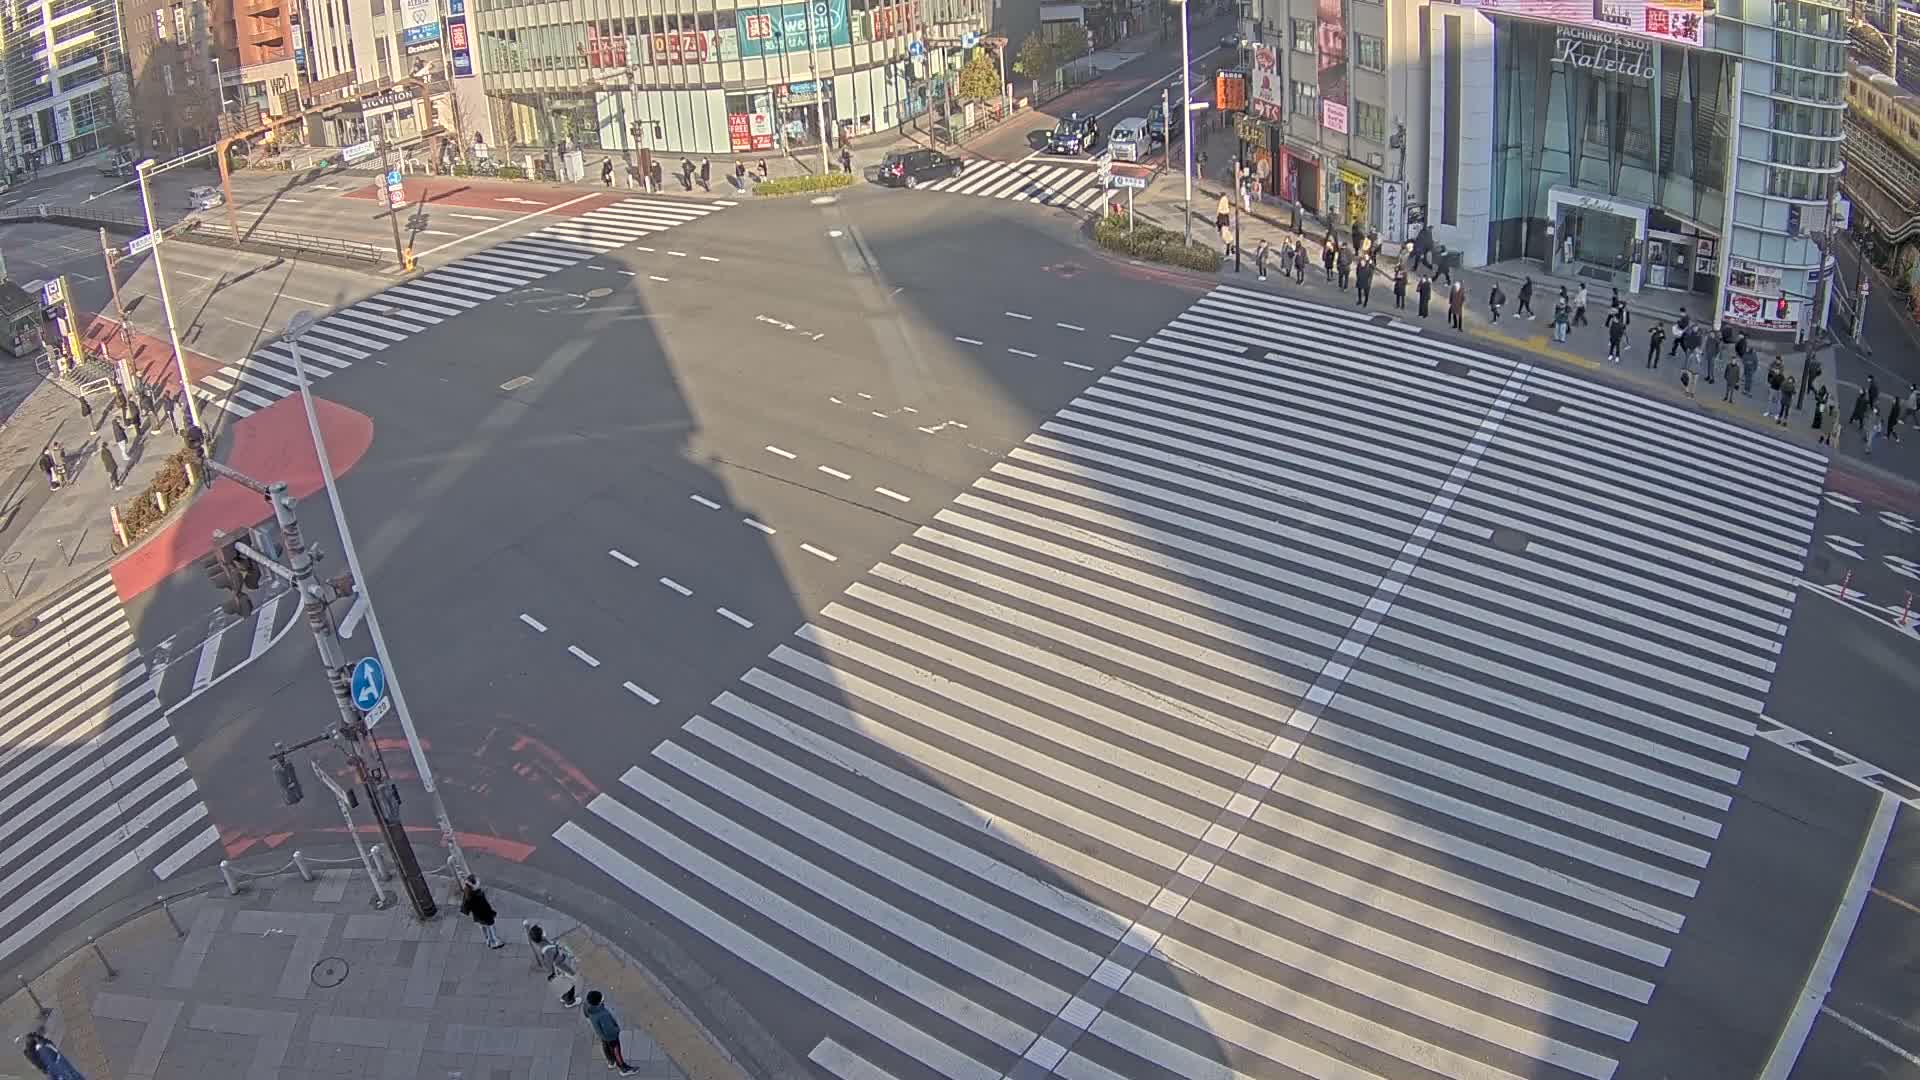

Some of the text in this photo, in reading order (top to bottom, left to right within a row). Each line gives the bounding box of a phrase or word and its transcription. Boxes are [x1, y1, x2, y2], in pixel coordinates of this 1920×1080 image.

[1556, 25, 1613, 45] PACHINKO
[1550, 38, 1656, 80] Kaleido
[730, 116, 746, 125] TAX
[730, 124, 749, 134] FREE
